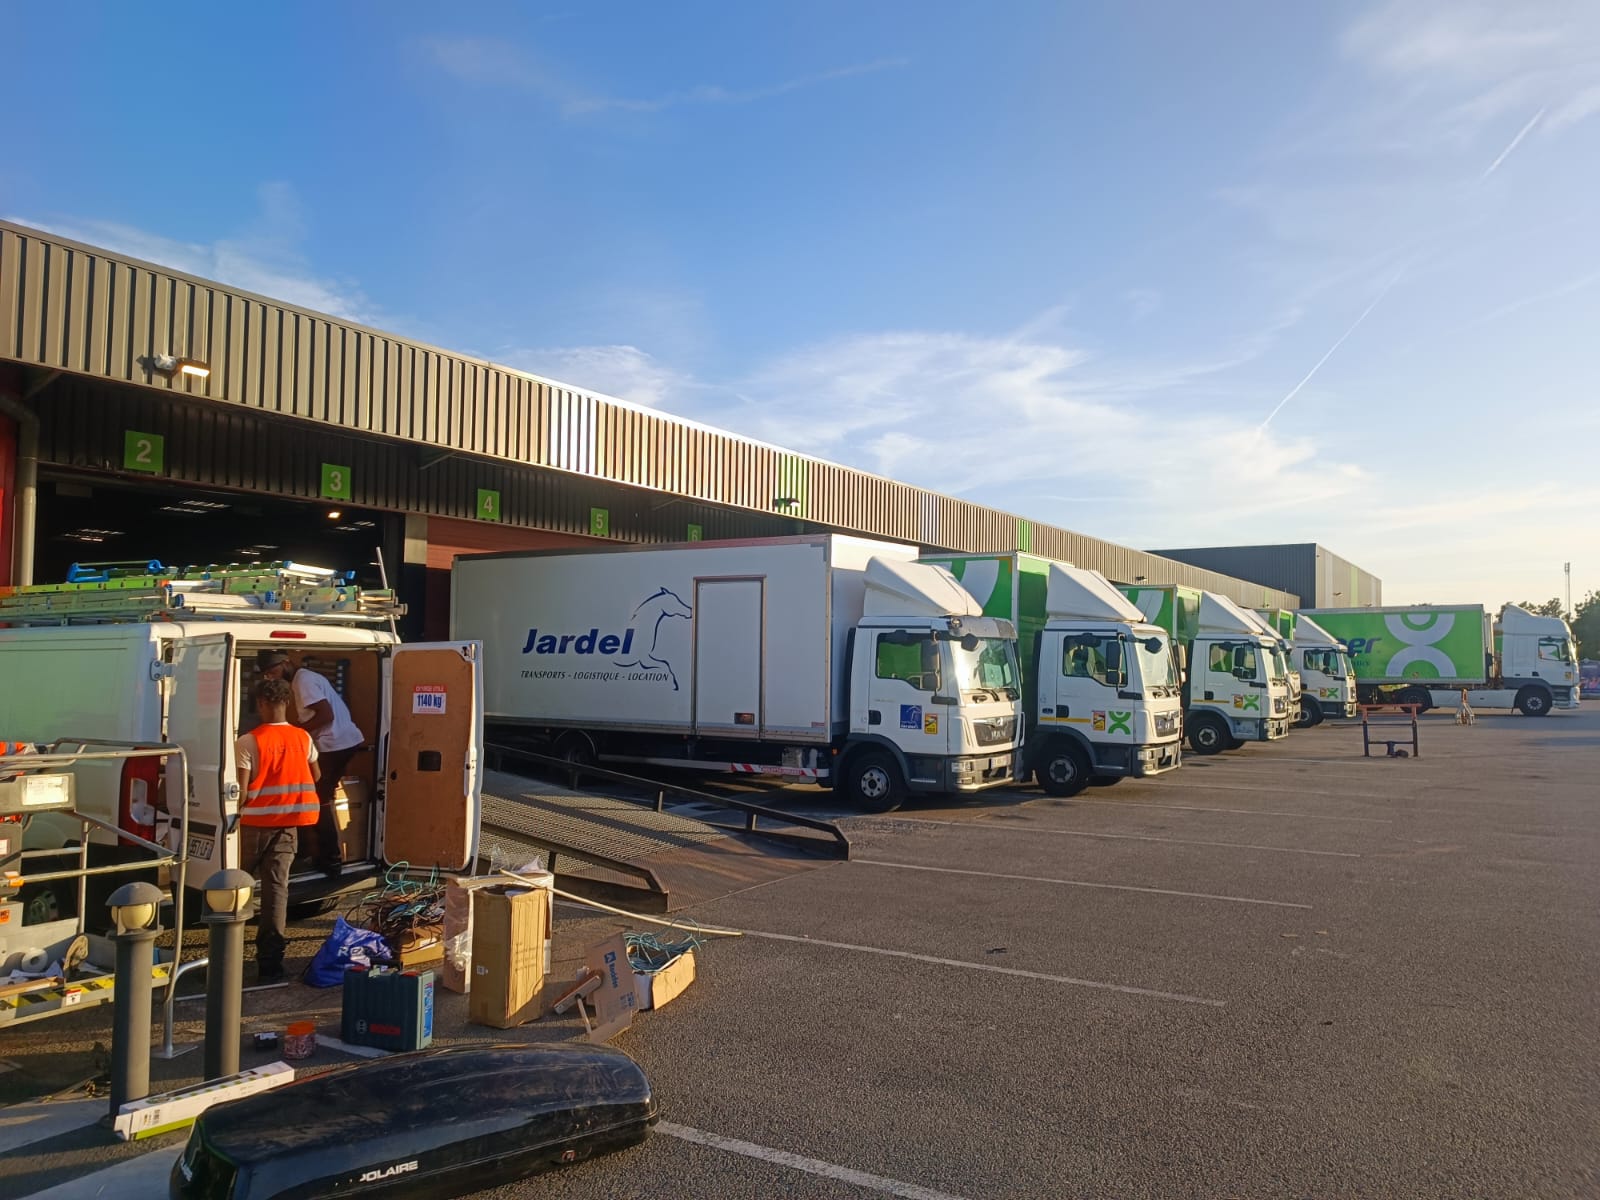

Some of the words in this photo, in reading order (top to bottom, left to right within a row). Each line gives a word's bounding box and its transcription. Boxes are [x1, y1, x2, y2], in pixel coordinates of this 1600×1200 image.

[136, 439, 151, 463] 2
[330, 471, 342, 492] 3
[484, 495, 493, 513] 4
[596, 513, 603, 529] 5
[522, 628, 635, 655] Jardel
[520, 670, 565, 680] TRANSPORTS
[573, 671, 619, 681] LOGISTIQUE
[628, 672, 669, 682] LOCATION
[417, 694, 432, 707] 1140
[433, 694, 442, 708] kg
